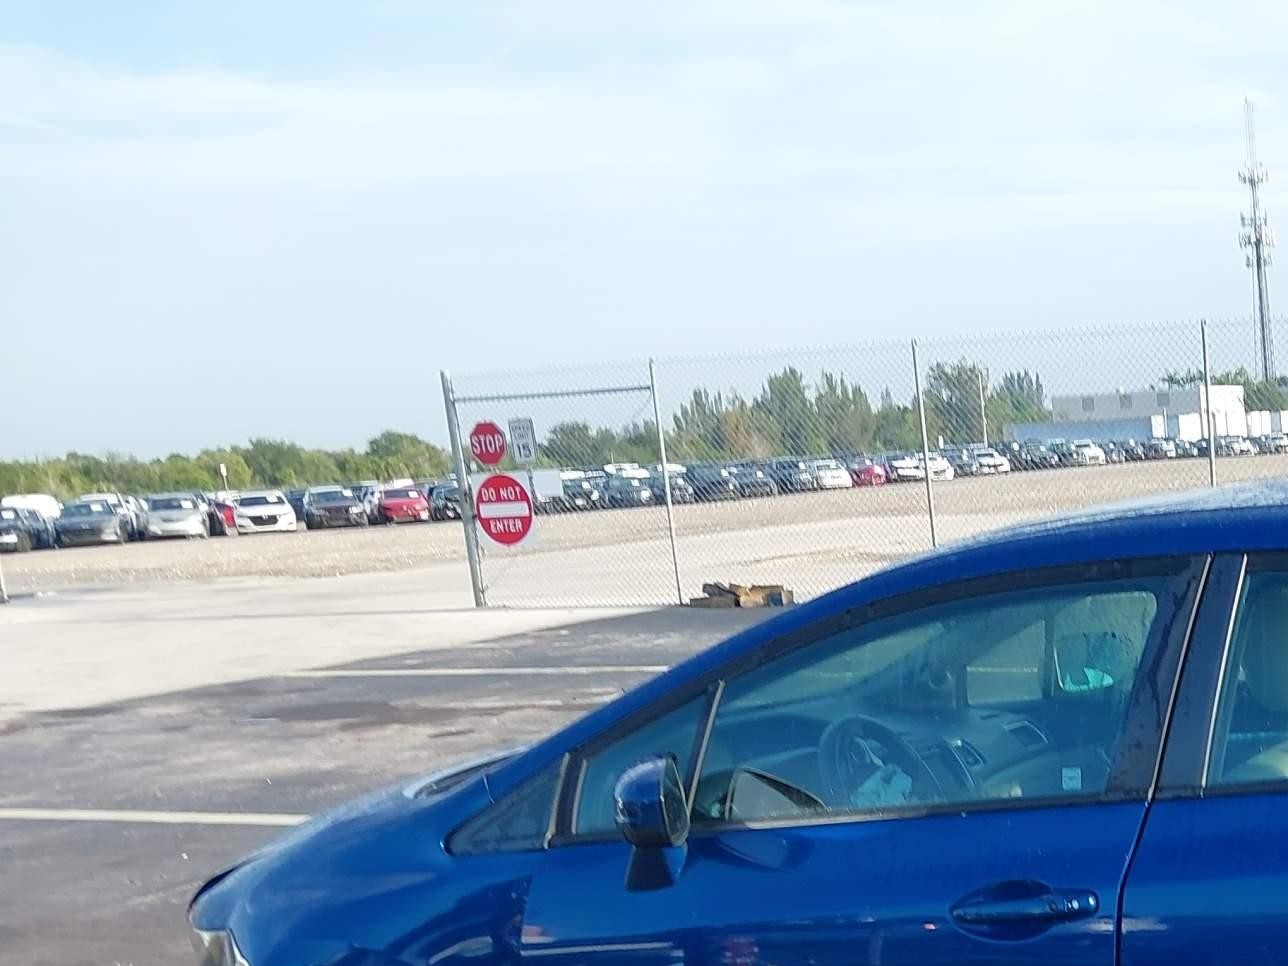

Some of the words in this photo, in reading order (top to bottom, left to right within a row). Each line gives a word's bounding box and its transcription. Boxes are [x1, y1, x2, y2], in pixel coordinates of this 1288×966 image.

[471, 434, 504, 454] STOP
[481, 487, 497, 502] DO
[500, 486, 522, 501] NOT
[490, 519, 523, 534] ENTER
